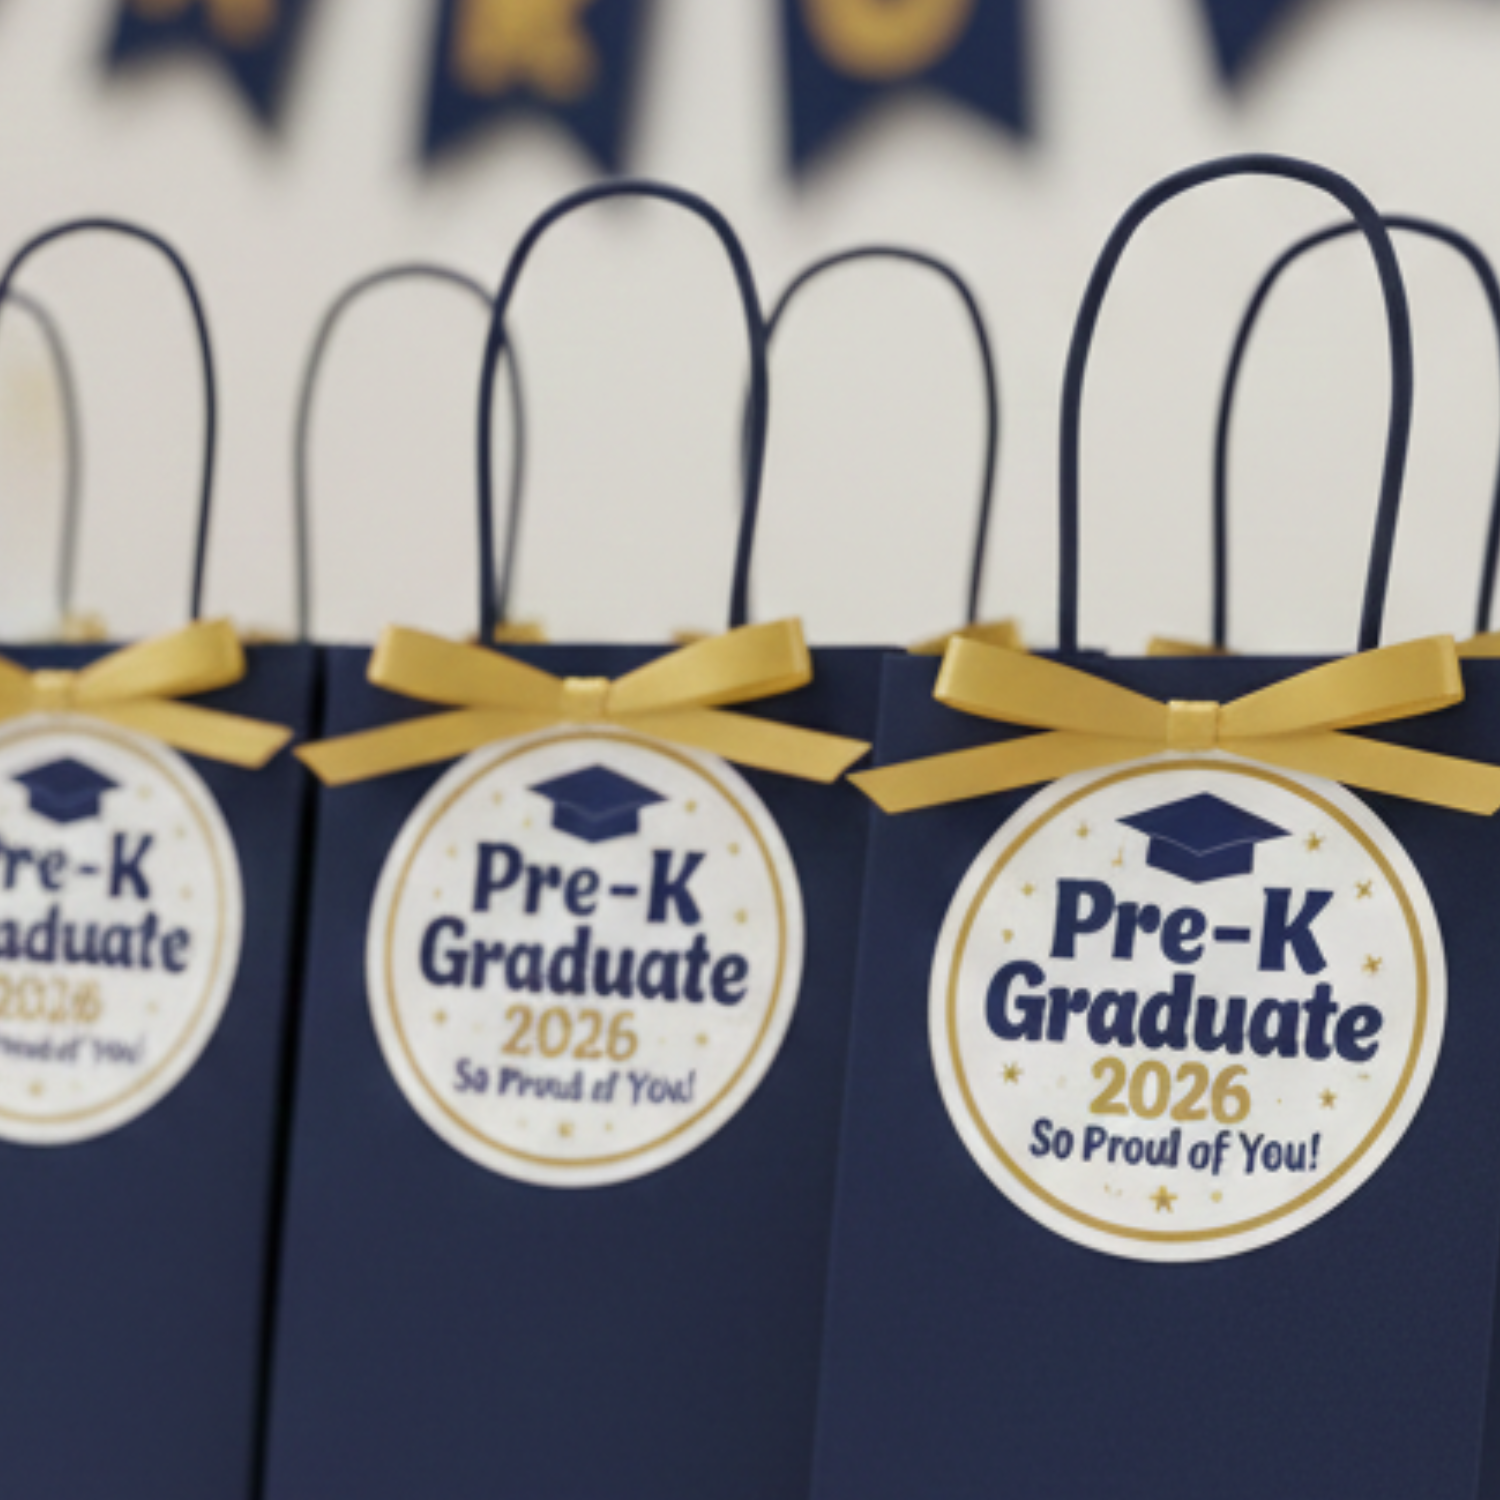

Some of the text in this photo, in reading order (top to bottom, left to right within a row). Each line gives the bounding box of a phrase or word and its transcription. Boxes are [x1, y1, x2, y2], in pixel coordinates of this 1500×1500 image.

[471, 841, 708, 927] Pre-K
[419, 914, 750, 1007] Graduate
[1049, 878, 1334, 975] Pre-K
[501, 1004, 639, 1062] 2026
[985, 960, 1384, 1063] Graduate
[498, 1066, 583, 1103] Proud
[627, 1069, 696, 1105] You!
[1089, 1056, 1251, 1124] 2026
[1029, 1117, 1074, 1160] So
[1188, 1129, 1232, 1176] of
[1238, 1131, 1322, 1175] You!
